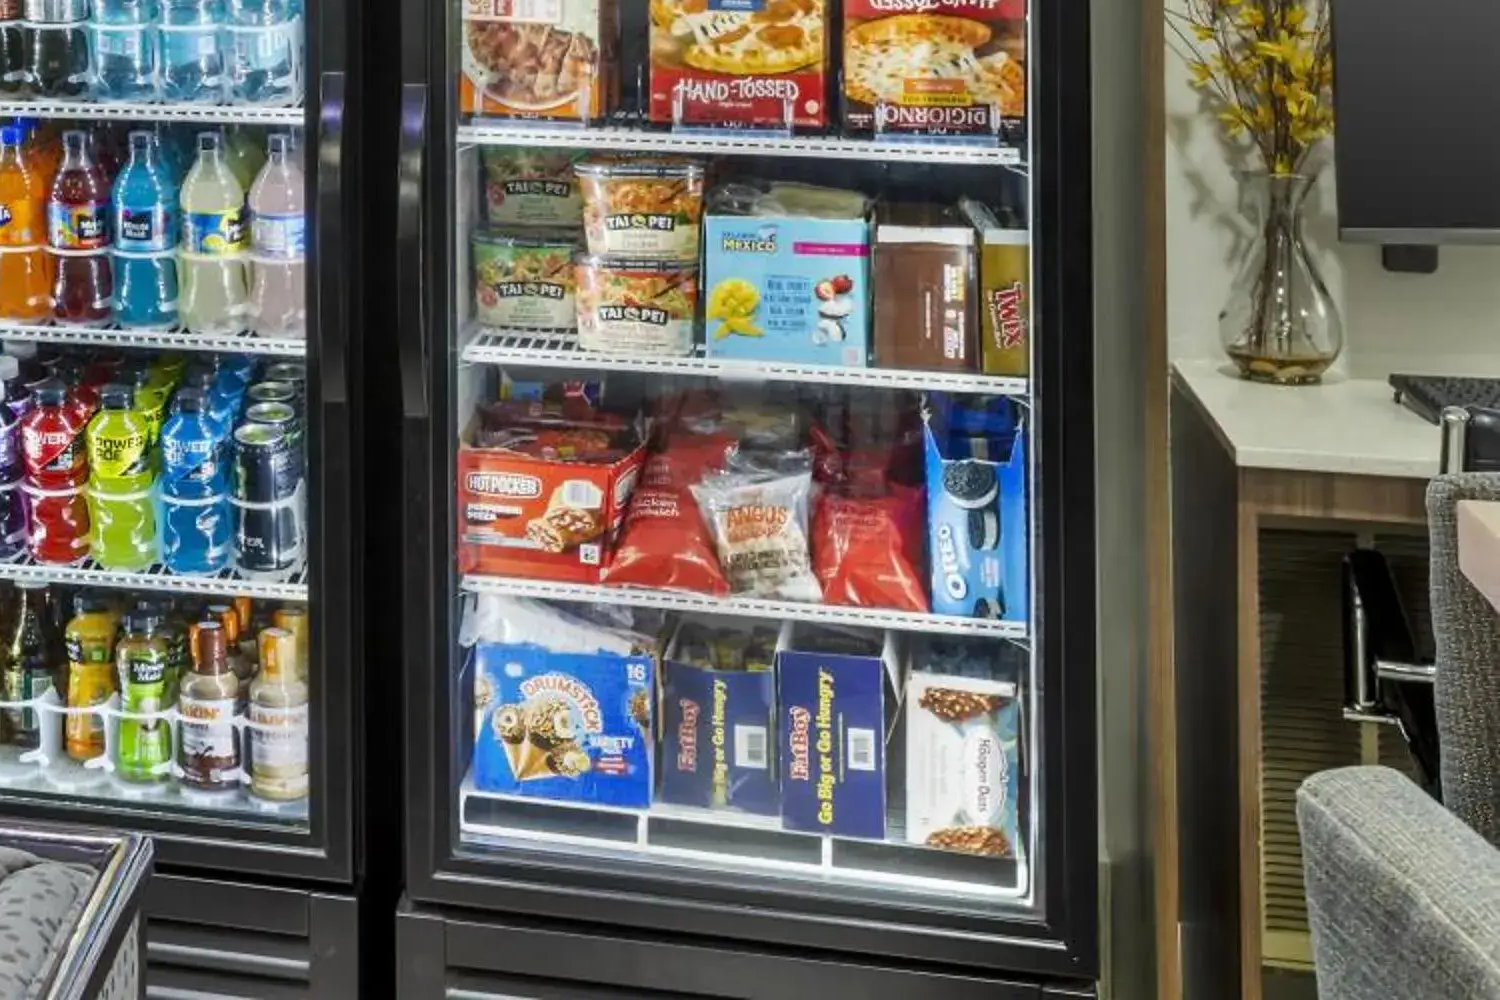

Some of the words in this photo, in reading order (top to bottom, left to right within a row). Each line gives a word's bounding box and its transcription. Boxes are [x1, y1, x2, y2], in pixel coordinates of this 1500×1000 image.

[507, 182, 528, 193] TAI
[544, 183, 569, 196] PEI
[607, 215, 630, 230] TAI
[648, 215, 673, 230] PEI
[723, 239, 776, 252] MEXICO
[500, 284, 523, 297] TAI
[540, 285, 564, 299] PEI
[600, 307, 623, 320] TAI
[641, 308, 666, 324] PEI
[995, 281, 1023, 348] TWIX
[938, 524, 968, 600] OREO
[521, 677, 602, 733] DRUMSTICK
[712, 679, 728, 725] Hungry
[816, 670, 835, 729] Hungry
[712, 725, 726, 747] Go
[790, 705, 811, 781] FatBoy
[816, 729, 832, 752] Go
[820, 755, 833, 771] or
[817, 772, 836, 801] Big
[817, 802, 833, 825] Go
